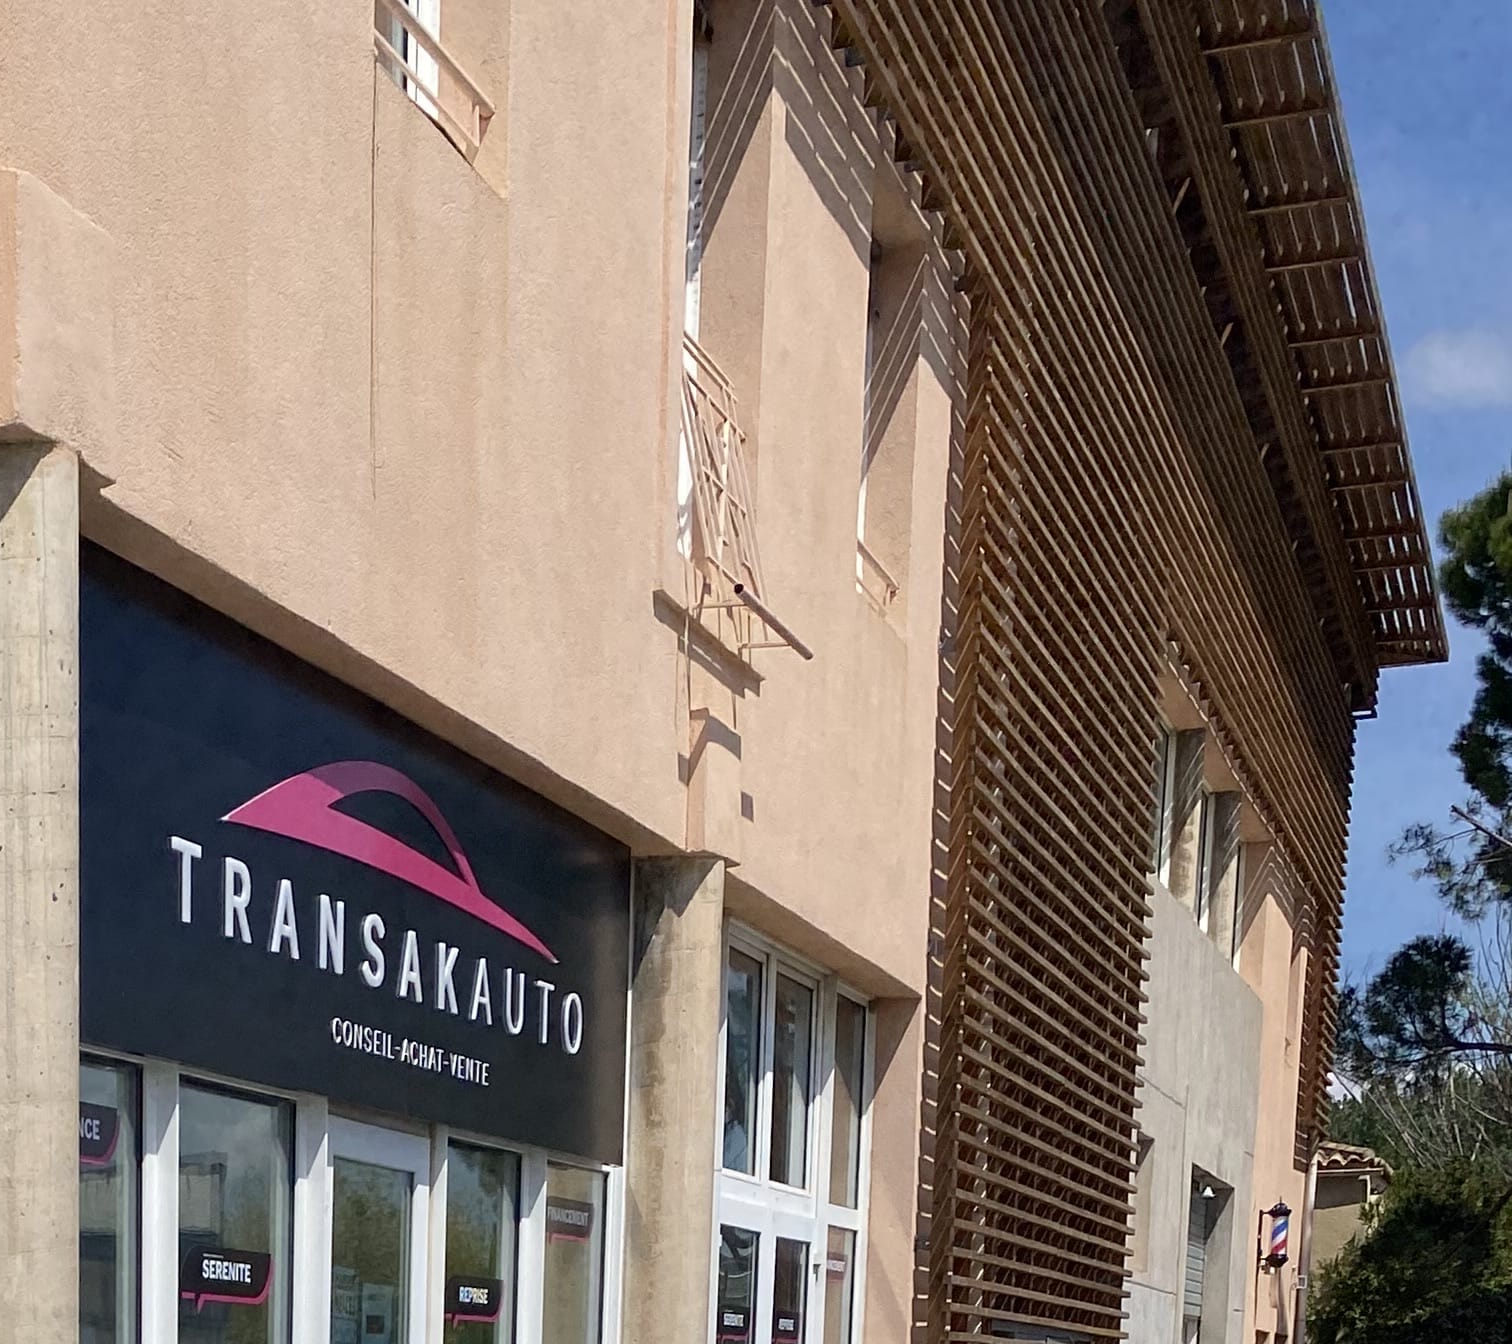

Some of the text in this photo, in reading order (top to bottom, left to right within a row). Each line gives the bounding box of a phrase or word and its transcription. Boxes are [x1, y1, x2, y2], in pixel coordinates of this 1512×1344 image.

[168, 835, 584, 1055] TRANSAKAUTO
[331, 1017, 490, 1087] CONSEIL-ACHAT-VENTE
[201, 1258, 252, 1284] SERENITE
